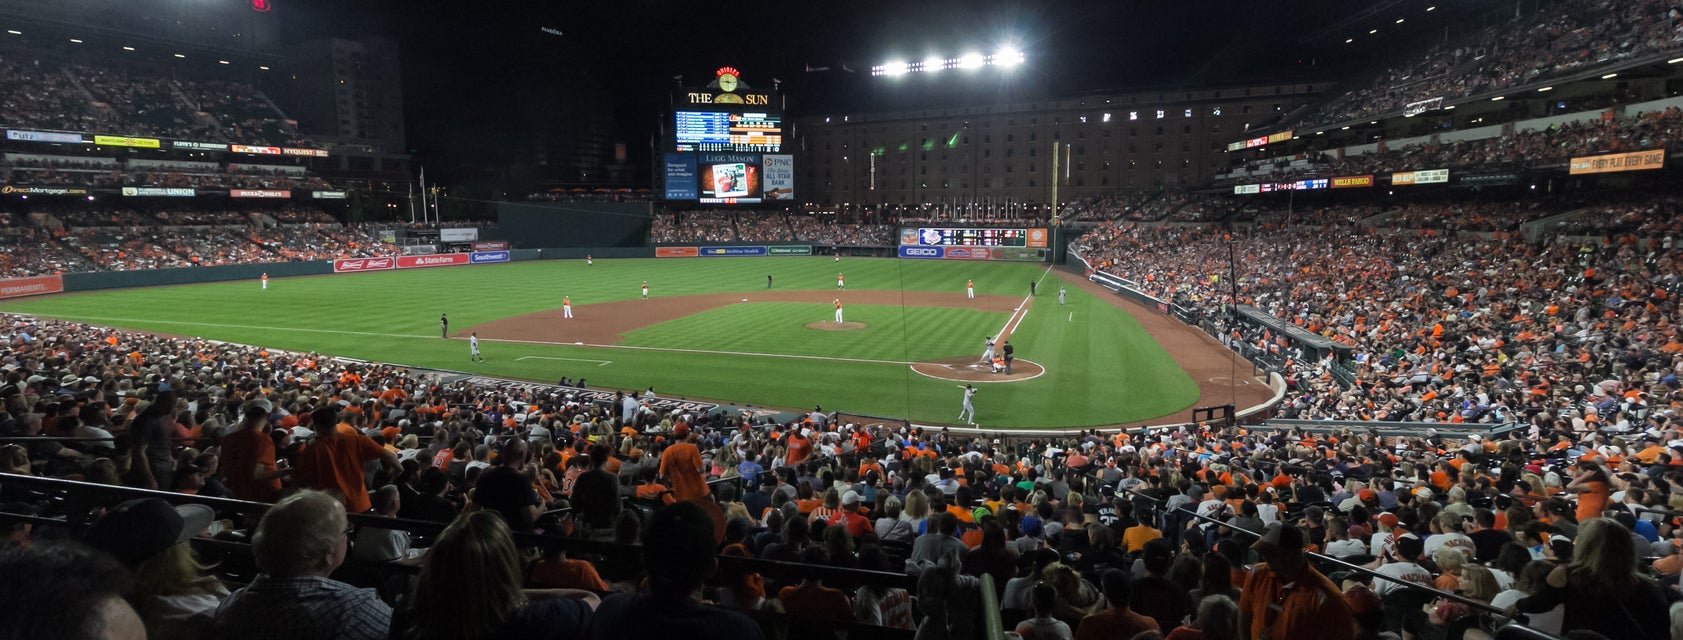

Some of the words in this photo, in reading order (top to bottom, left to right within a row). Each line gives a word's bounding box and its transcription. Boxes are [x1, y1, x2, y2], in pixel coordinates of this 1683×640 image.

[717, 67, 740, 78] ORIOLES
[688, 93, 713, 105] THE
[745, 95, 769, 105] SUN
[706, 154, 726, 163] LEGG
[727, 155, 755, 164] MASON
[774, 158, 792, 167] PNC
[1334, 178, 1352, 187] WELLS
[1352, 177, 1370, 186] FARGO
[166, 188, 195, 196] UNION
[906, 248, 937, 256] GEICO
